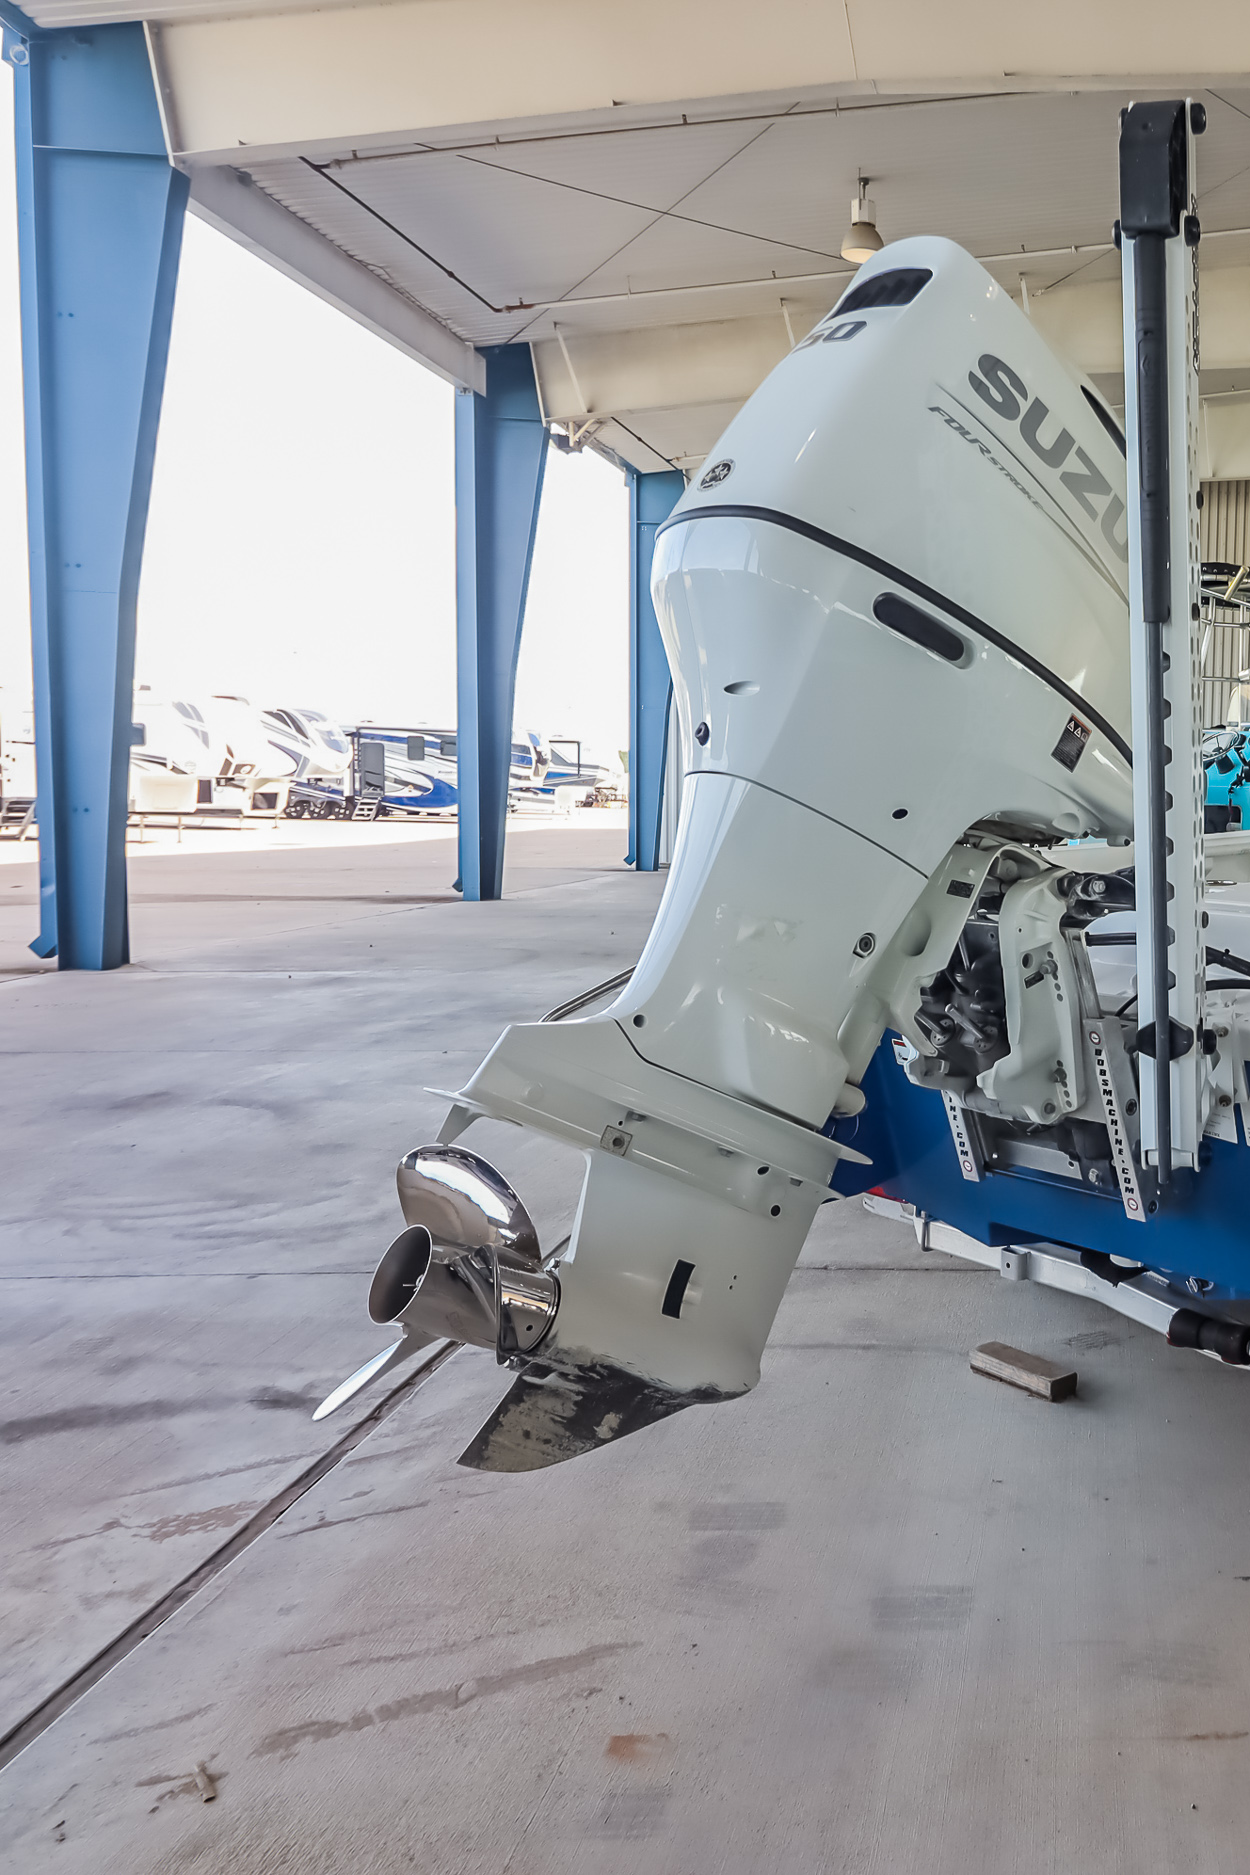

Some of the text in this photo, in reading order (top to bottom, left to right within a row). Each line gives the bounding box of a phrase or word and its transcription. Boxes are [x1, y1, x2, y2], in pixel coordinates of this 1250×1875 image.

[928, 406, 991, 457] FOUR
[944, 1090, 969, 1157] INE.COM
[1094, 1048, 1135, 1195] BOBSMACHINE.COM
